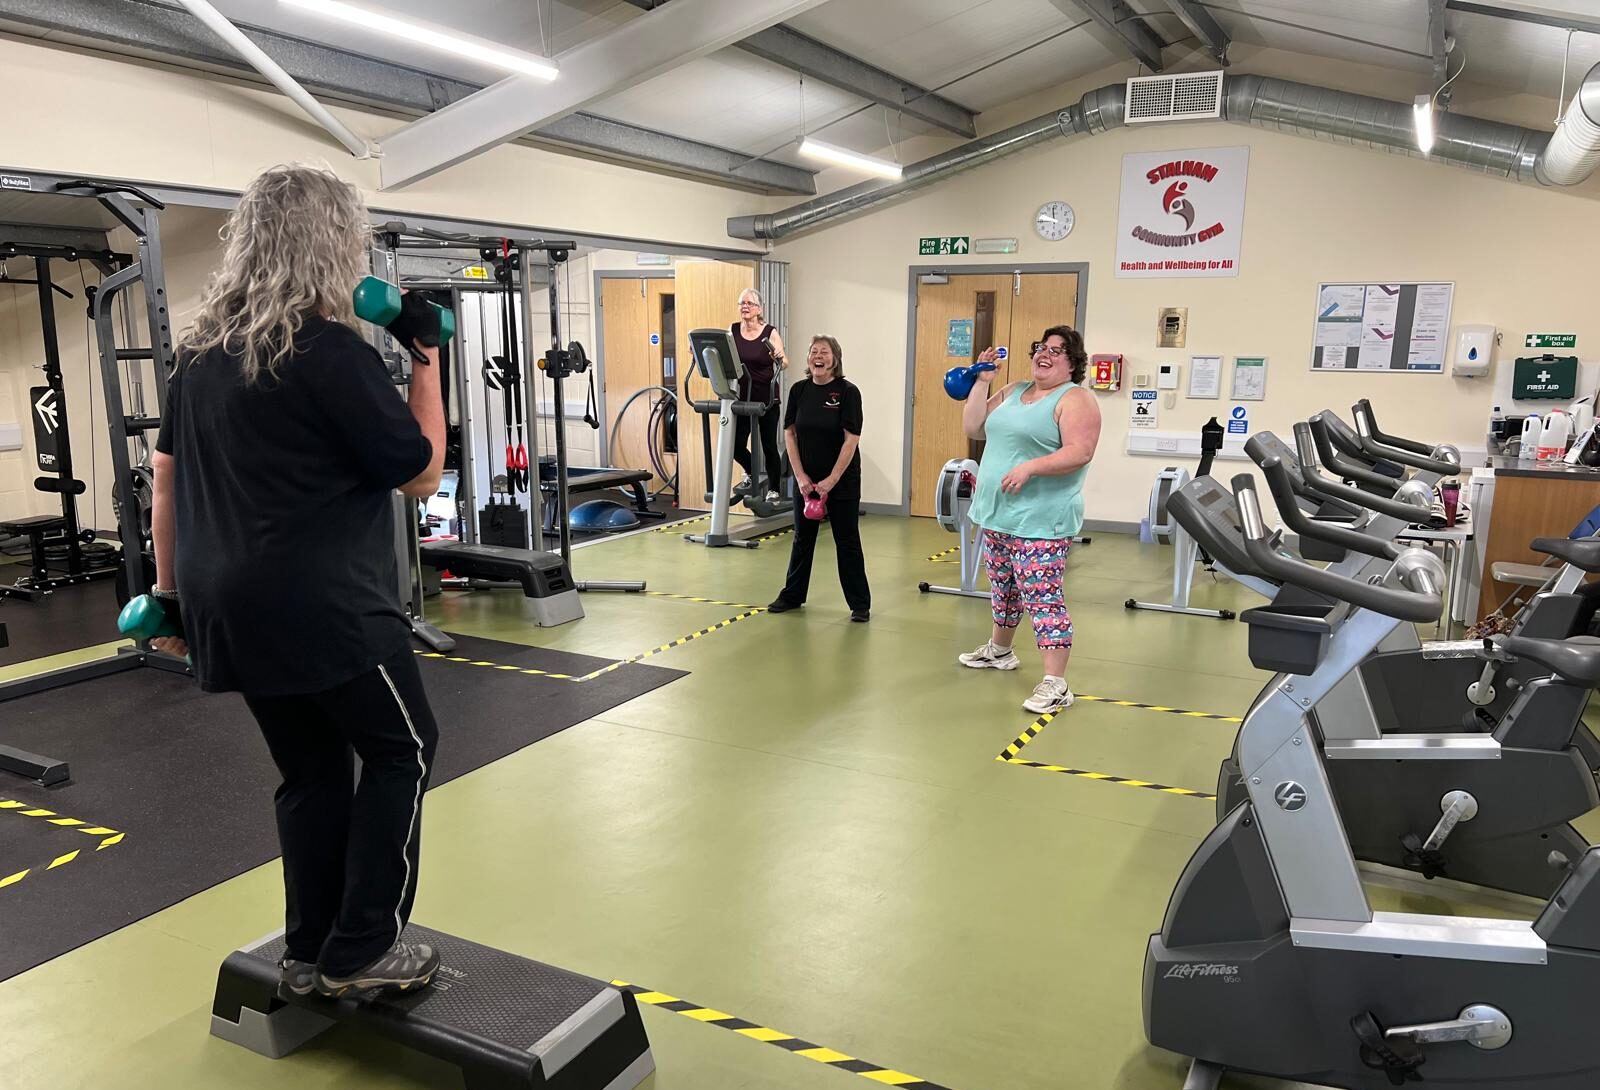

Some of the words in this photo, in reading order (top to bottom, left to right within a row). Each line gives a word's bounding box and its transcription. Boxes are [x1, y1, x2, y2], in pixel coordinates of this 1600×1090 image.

[1132, 225, 1196, 247] COMMUNITY
[1198, 222, 1224, 242] GYM
[921, 239, 936, 247] Fire
[1120, 261, 1146, 271] Health
[1148, 261, 1163, 270] and
[1164, 260, 1207, 271] Wellbeing
[1208, 260, 1221, 269] for
[1222, 259, 1233, 269] All
